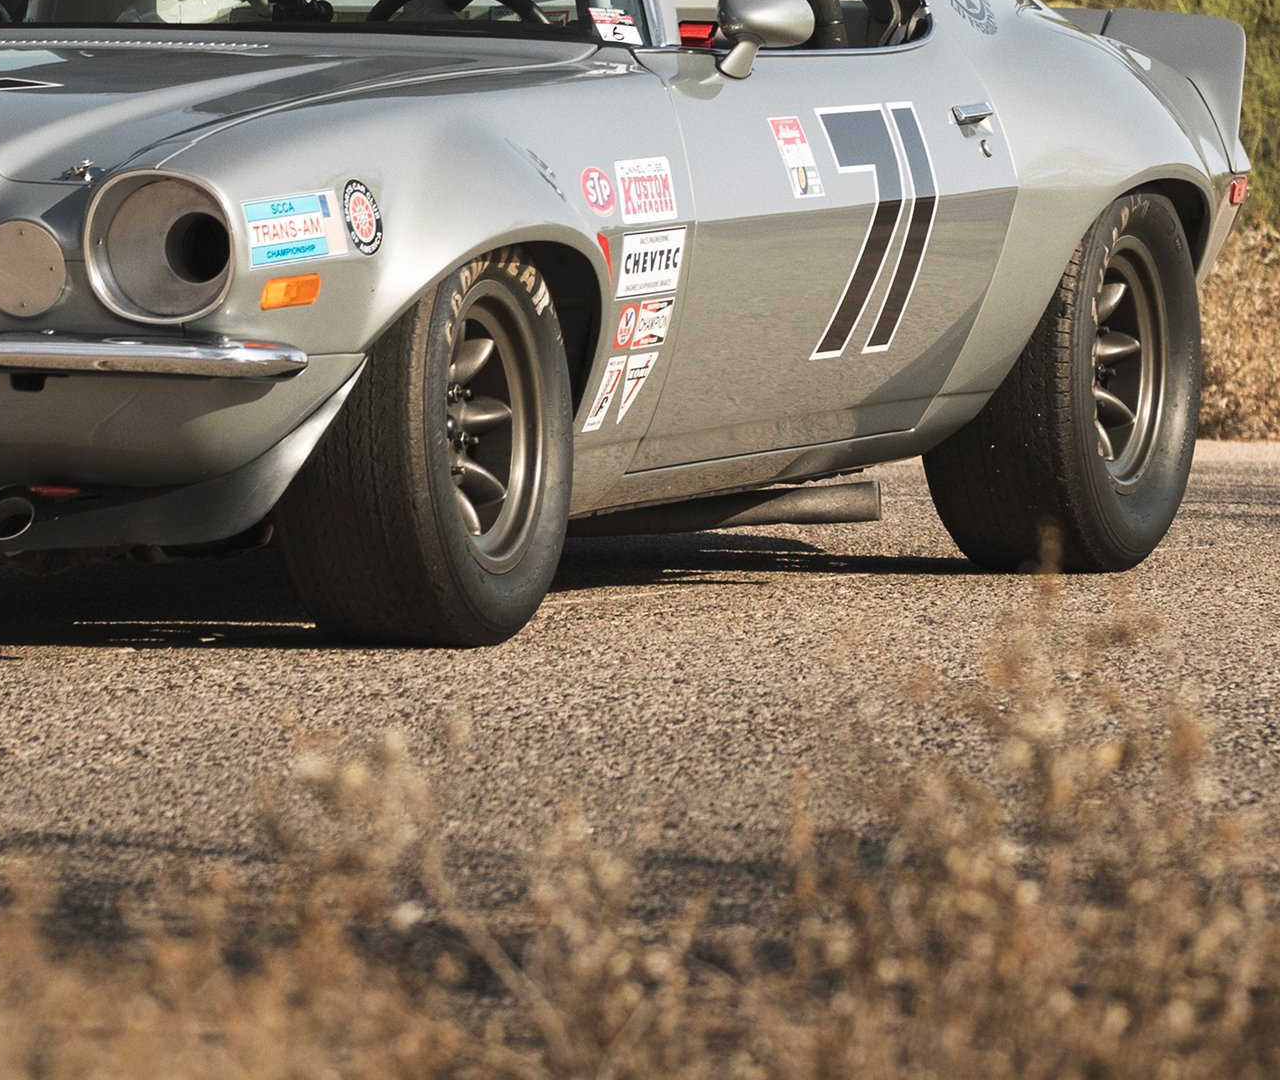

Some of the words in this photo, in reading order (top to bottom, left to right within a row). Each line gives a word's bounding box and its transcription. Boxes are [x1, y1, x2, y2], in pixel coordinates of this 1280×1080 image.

[352, 182, 366, 193] CAR
[585, 171, 611, 208] STP
[620, 173, 672, 215] KUSTOM
[271, 202, 295, 215] SCCA
[252, 217, 322, 244] TRANS-AM
[809, 101, 939, 360] 71
[266, 245, 316, 259] CHAMPIONSHIP
[624, 247, 680, 275] CHEVTEC
